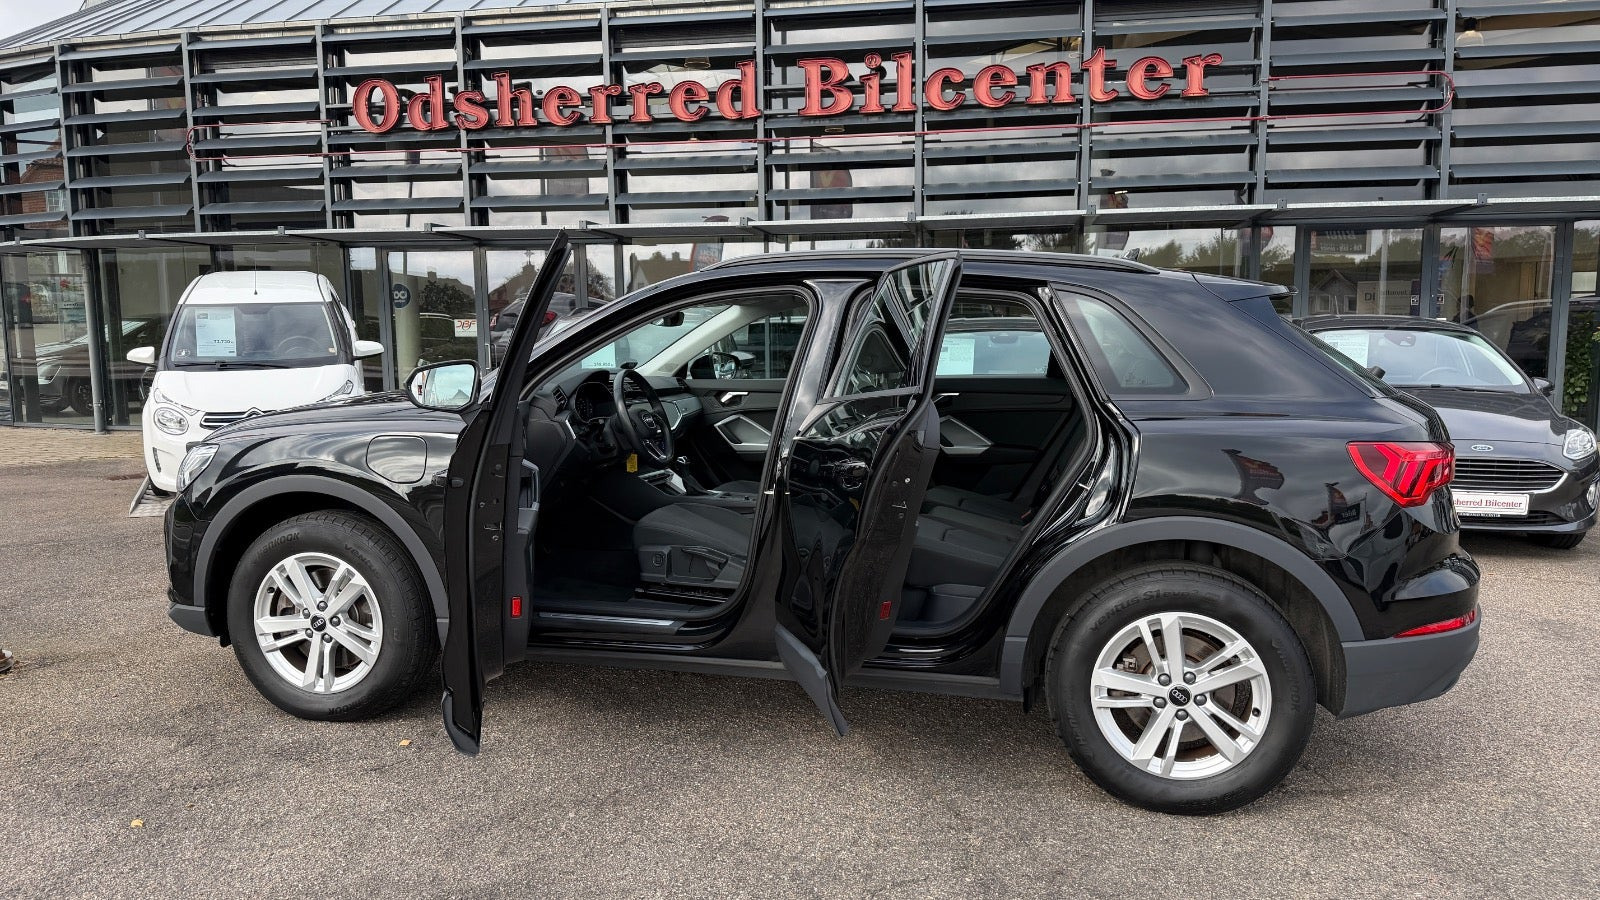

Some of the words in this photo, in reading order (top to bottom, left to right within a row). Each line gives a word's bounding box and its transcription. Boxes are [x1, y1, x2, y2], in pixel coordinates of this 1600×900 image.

[352, 59, 762, 134] Odsherred
[797, 45, 1224, 116] Bilcenter
[1485, 500, 1523, 508] Bilcenter
